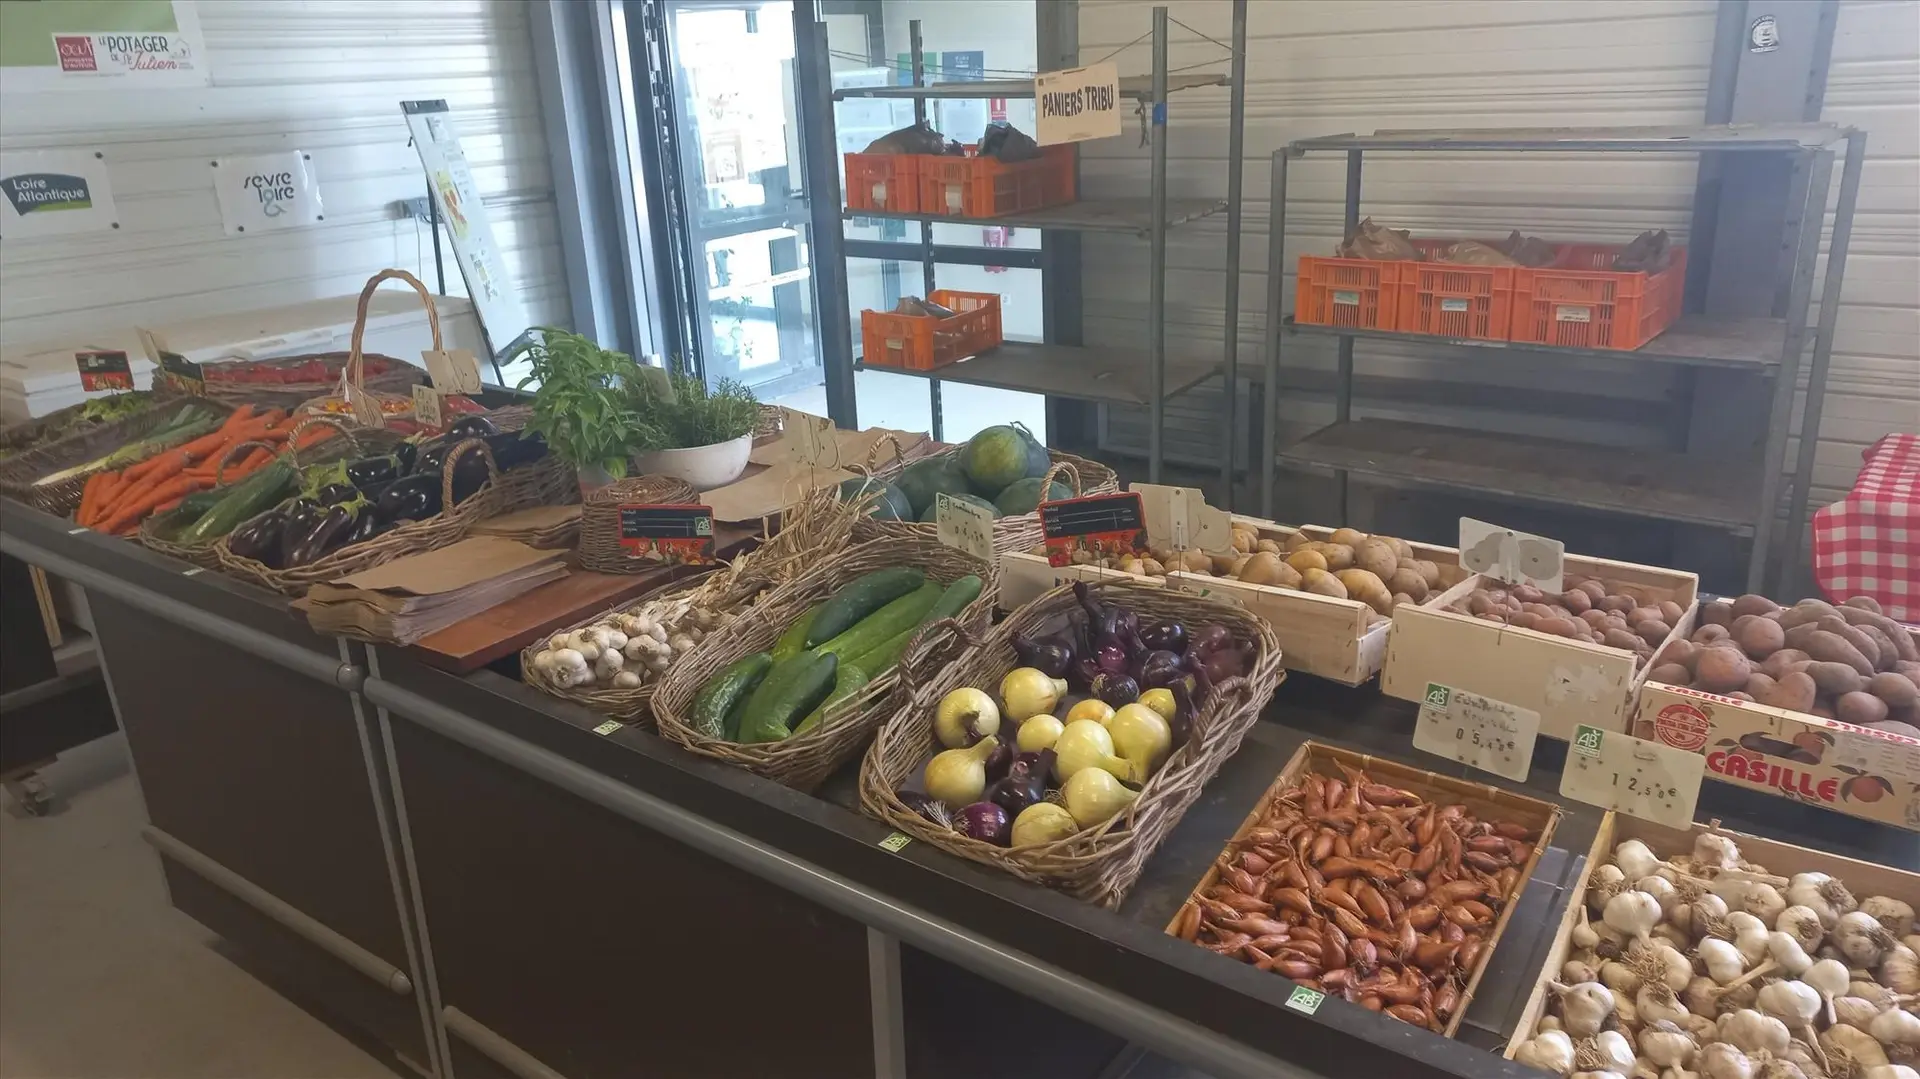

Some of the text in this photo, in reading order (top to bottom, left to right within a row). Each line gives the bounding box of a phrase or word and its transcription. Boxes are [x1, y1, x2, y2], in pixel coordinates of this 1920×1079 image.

[106, 35, 169, 53] POTAGER
[129, 50, 178, 70] Julien
[1042, 84, 1114, 118] PANIERS TRIBU
[12, 178, 47, 190] Loire
[17, 188, 85, 203] Atlantique
[257, 186, 295, 203] loire
[1427, 687, 1448, 705] AB
[1577, 729, 1600, 748] AB
[1292, 991, 1320, 1007] AB
